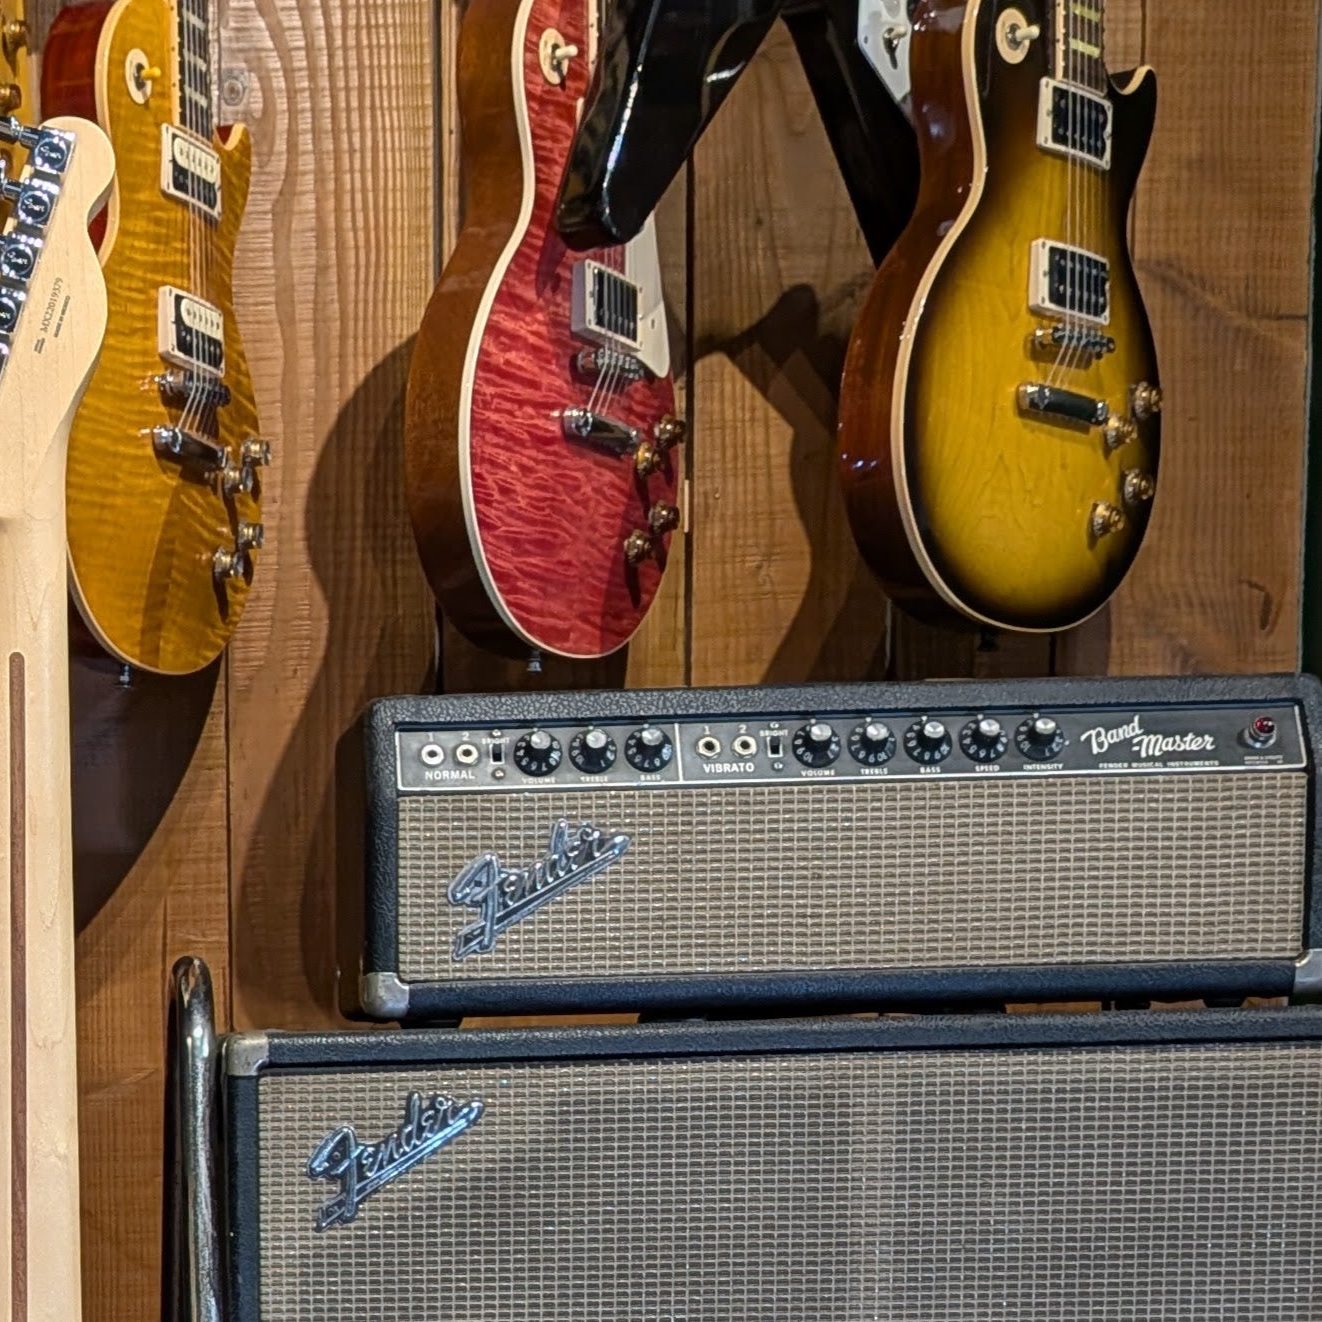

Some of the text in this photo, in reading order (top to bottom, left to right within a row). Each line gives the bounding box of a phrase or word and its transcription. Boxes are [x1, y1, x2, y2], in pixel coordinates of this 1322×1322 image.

[1080, 714, 1145, 755] Band
[703, 763, 755, 773] VIBRATO
[800, 769, 836, 777] VOLUME
[860, 767, 888, 775] TREBLE
[919, 766, 941, 774] BASS
[974, 764, 1000, 772] SPEED
[425, 770, 476, 780] NORMAL
[448, 818, 630, 962] Fender
[306, 1090, 486, 1233] Fender
